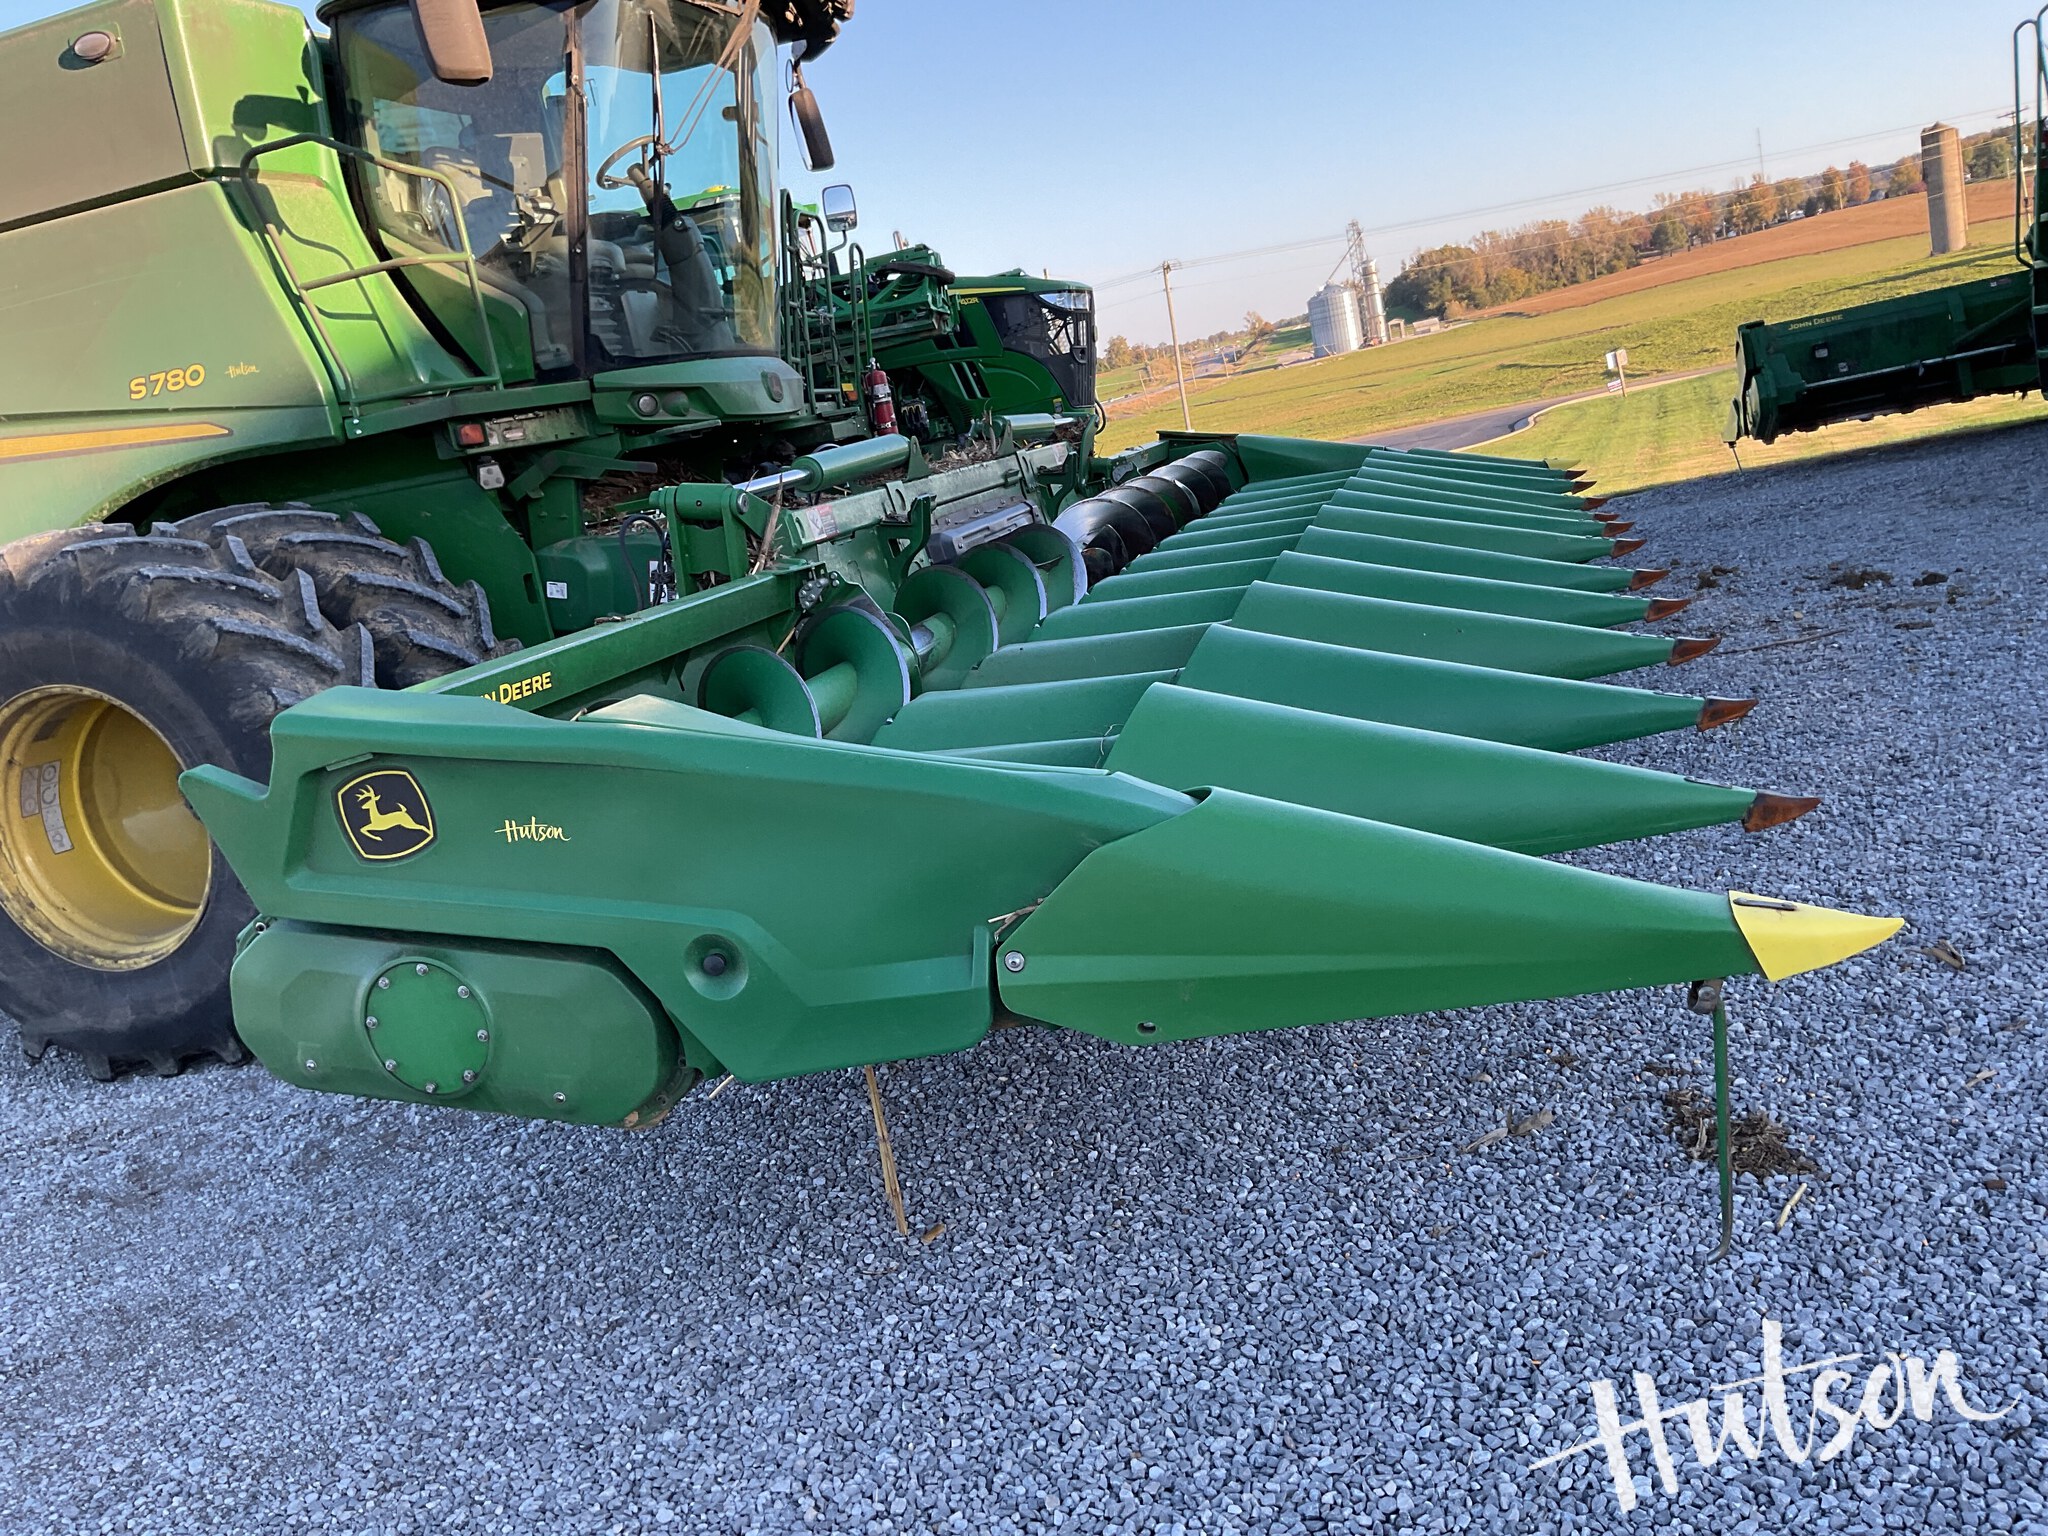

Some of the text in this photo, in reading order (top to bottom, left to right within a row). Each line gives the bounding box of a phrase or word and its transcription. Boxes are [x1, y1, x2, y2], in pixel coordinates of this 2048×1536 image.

[1787, 314, 1843, 331] JOHN DEERE
[129, 363, 206, 400] S780
[499, 671, 552, 705] DEERE
[494, 815, 572, 843] Hutson
